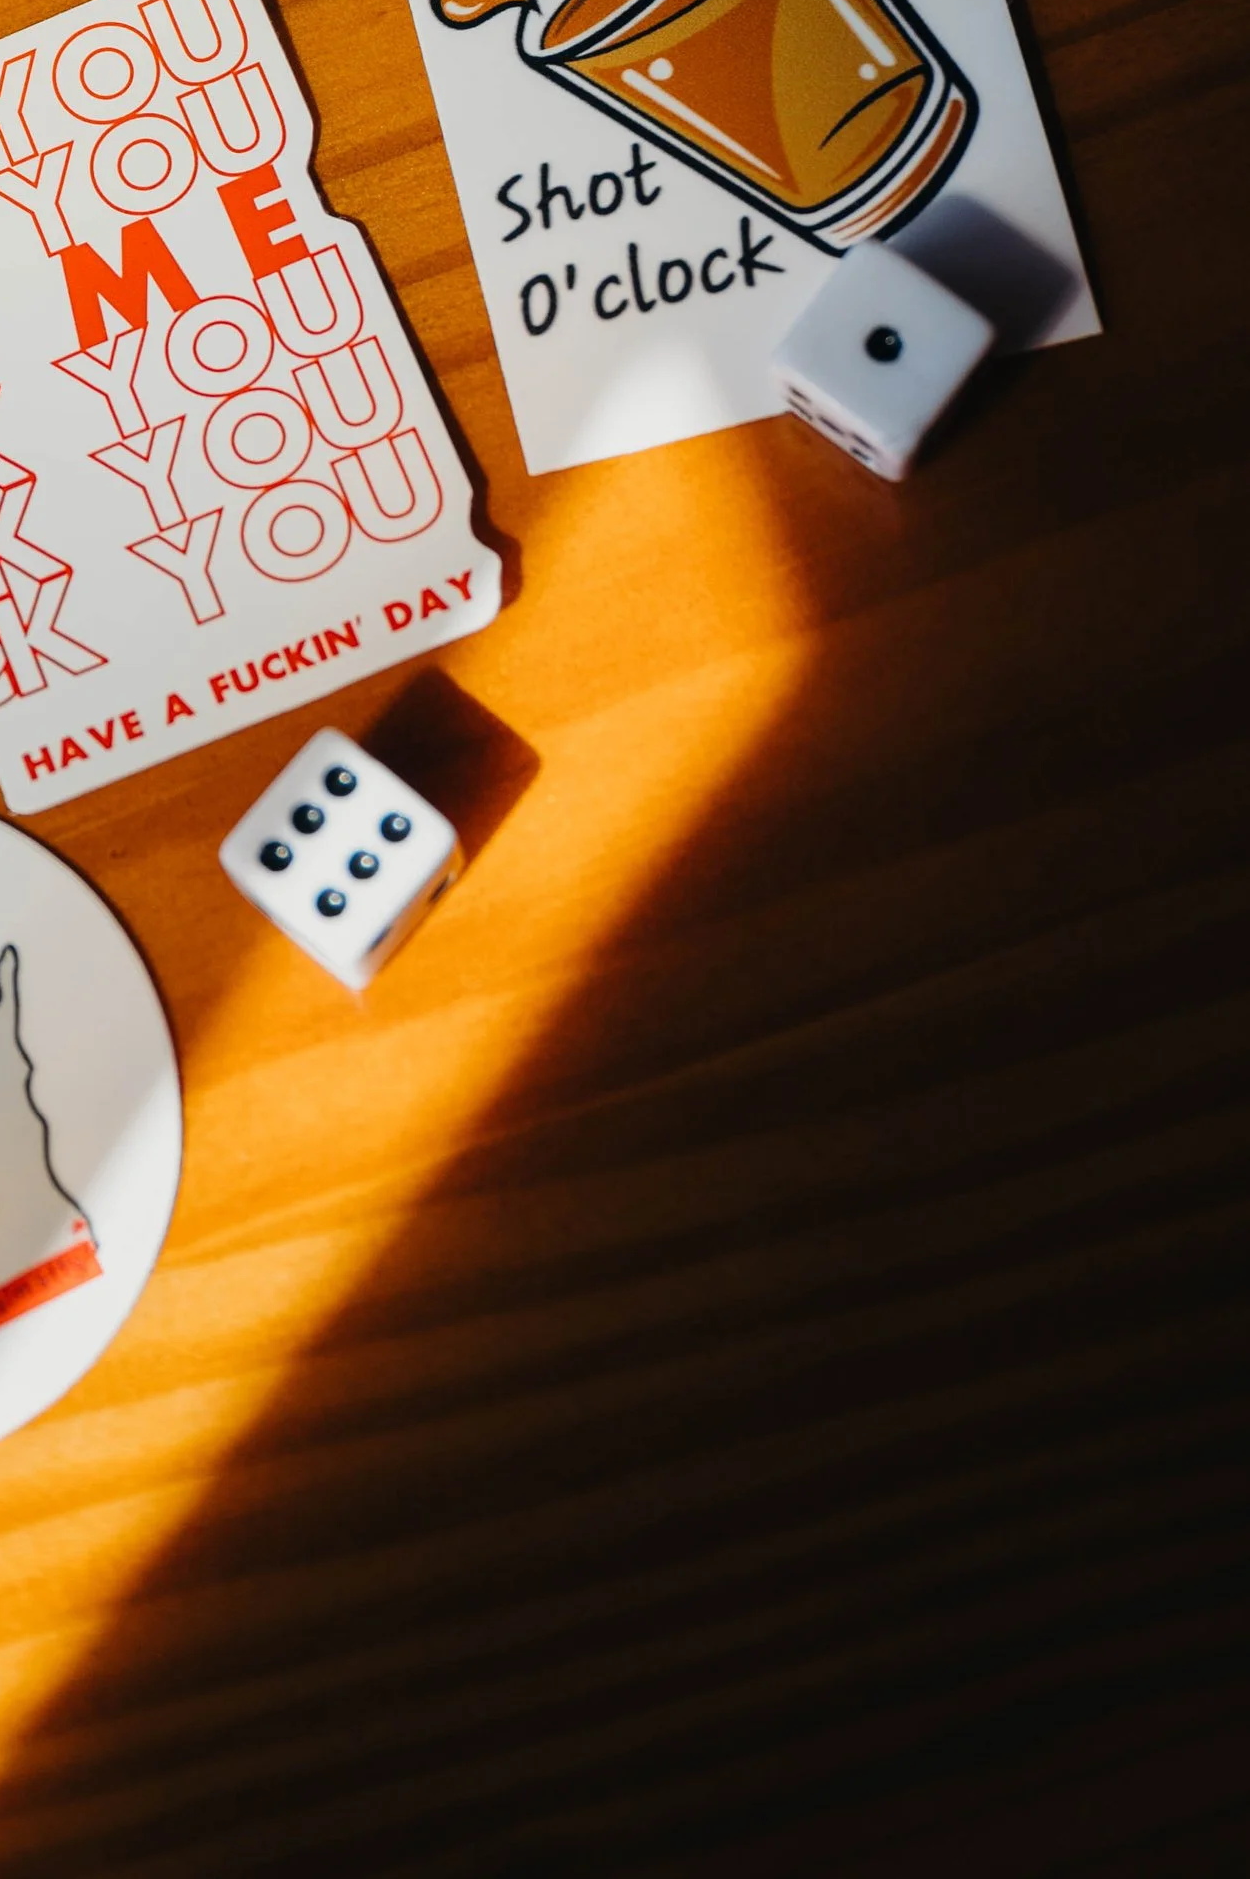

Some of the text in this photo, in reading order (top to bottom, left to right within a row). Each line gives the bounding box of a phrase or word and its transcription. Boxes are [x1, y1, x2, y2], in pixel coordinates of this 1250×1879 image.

[59, 164, 316, 353] ME
[496, 143, 663, 243] Shot
[518, 216, 786, 337] O'clock
[51, 245, 365, 439] YOU
[89, 337, 403, 531] YOU
[126, 429, 444, 625] YOU
[21, 571, 478, 783] HAVE A FUCKIN' DAY
